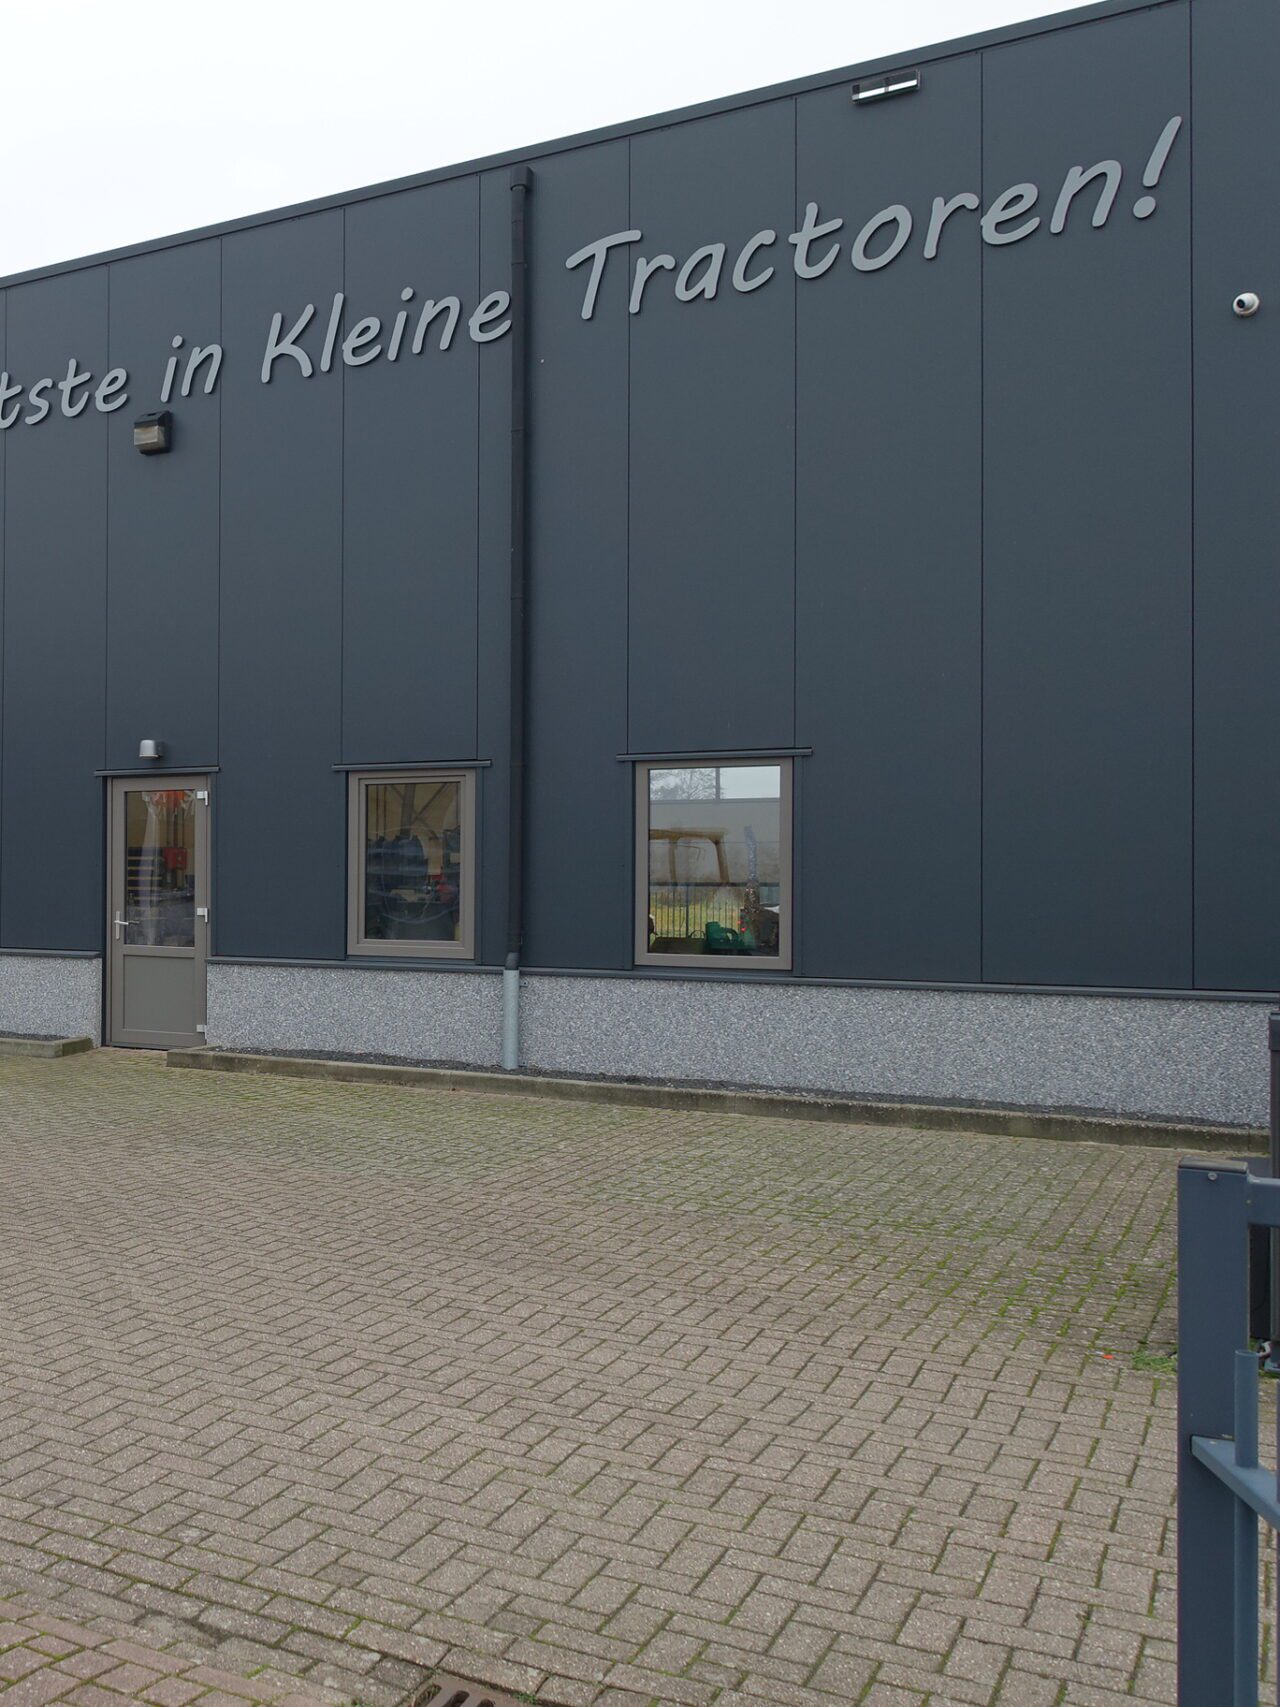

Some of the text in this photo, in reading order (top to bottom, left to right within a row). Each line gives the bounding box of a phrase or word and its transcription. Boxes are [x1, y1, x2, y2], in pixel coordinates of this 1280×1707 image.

[159, 334, 223, 402] in
[260, 286, 514, 384] Kleine
[565, 115, 1183, 321] Tractoren!
